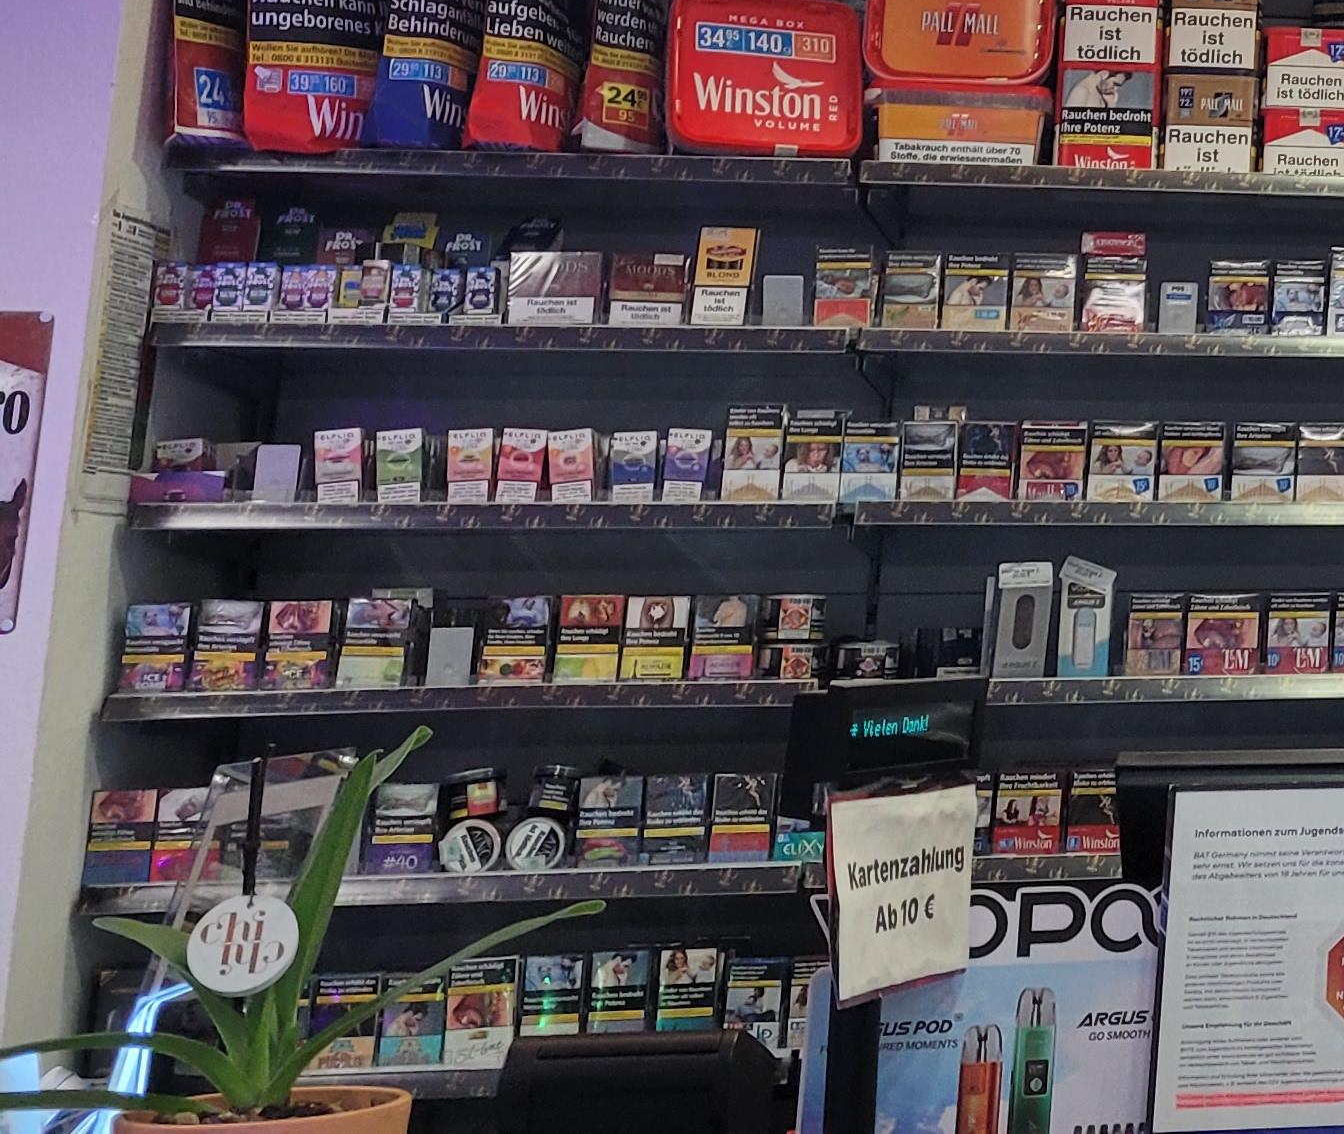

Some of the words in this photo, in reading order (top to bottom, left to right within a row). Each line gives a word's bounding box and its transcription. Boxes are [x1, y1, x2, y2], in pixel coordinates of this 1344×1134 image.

[251, 9, 371, 35] ungeborenes
[597, 9, 647, 32] werden
[728, 14, 768, 26] MEGA
[776, 18, 806, 30] BOX
[921, 11, 954, 34] PALL
[964, 13, 999, 35] MALL
[1070, 6, 1152, 24] Rauchen
[1174, 11, 1253, 29] Rauchen
[486, 17, 544, 46] Lieben
[1099, 25, 1122, 41] ist
[1202, 30, 1224, 46] ist
[802, 37, 830, 54] 310
[1077, 44, 1141, 61] tödlich
[1180, 48, 1243, 65] tödlich
[1280, 73, 1343, 87] Rauchen
[693, 71, 822, 121] Winston
[1276, 87, 1294, 100] ist
[1298, 88, 1344, 102] tödlich
[829, 94, 839, 122] RED
[1061, 109, 1107, 122] Rauchen
[1109, 109, 1152, 123] bedroht
[754, 118, 821, 133] VOLUME
[1060, 122, 1082, 133] Ihre
[1083, 122, 1121, 134] Potenz
[893, 142, 948, 154] Tabakrauch
[951, 143, 984, 154] enthält
[986, 144, 1008, 155] über
[923, 152, 938, 162] die
[863, 719, 898, 738] Vielen
[902, 714, 930, 735] Dank!
[1194, 828, 1272, 840] Informationen
[1275, 829, 1297, 837] zum
[1013, 836, 1053, 851] Winston
[847, 844, 966, 892] Kartenzahlung
[875, 905, 898, 934] Ab
[902, 896, 919, 927] 10
[924, 893, 937, 921] €
[915, 1019, 953, 1035] POD
[1076, 1010, 1150, 1029] ARGUS
[1088, 1032, 1105, 1042] GO
[1106, 1029, 1151, 1041] SMOOTH
[902, 1039, 959, 1052] MOMENTS
